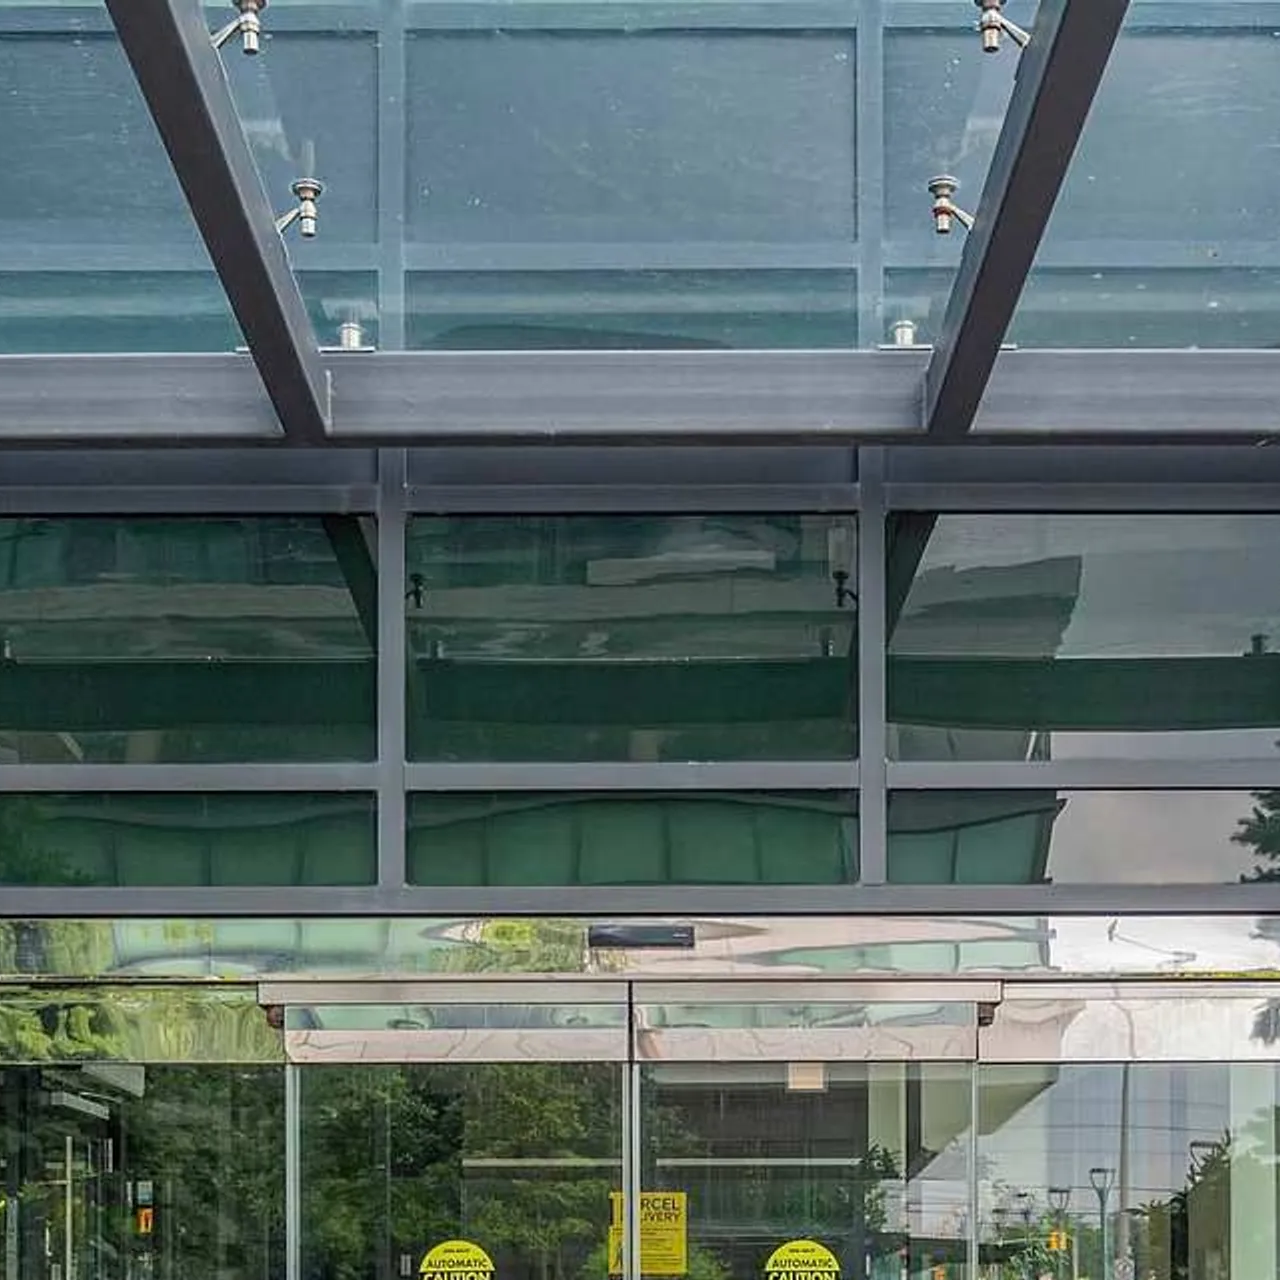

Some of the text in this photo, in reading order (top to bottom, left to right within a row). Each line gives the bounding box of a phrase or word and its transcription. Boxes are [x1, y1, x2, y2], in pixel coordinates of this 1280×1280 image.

[620, 1198, 678, 1211] RCEL
[427, 1259, 489, 1269] AUTOMATIC
[772, 1258, 833, 1269] AUTOMATIC
